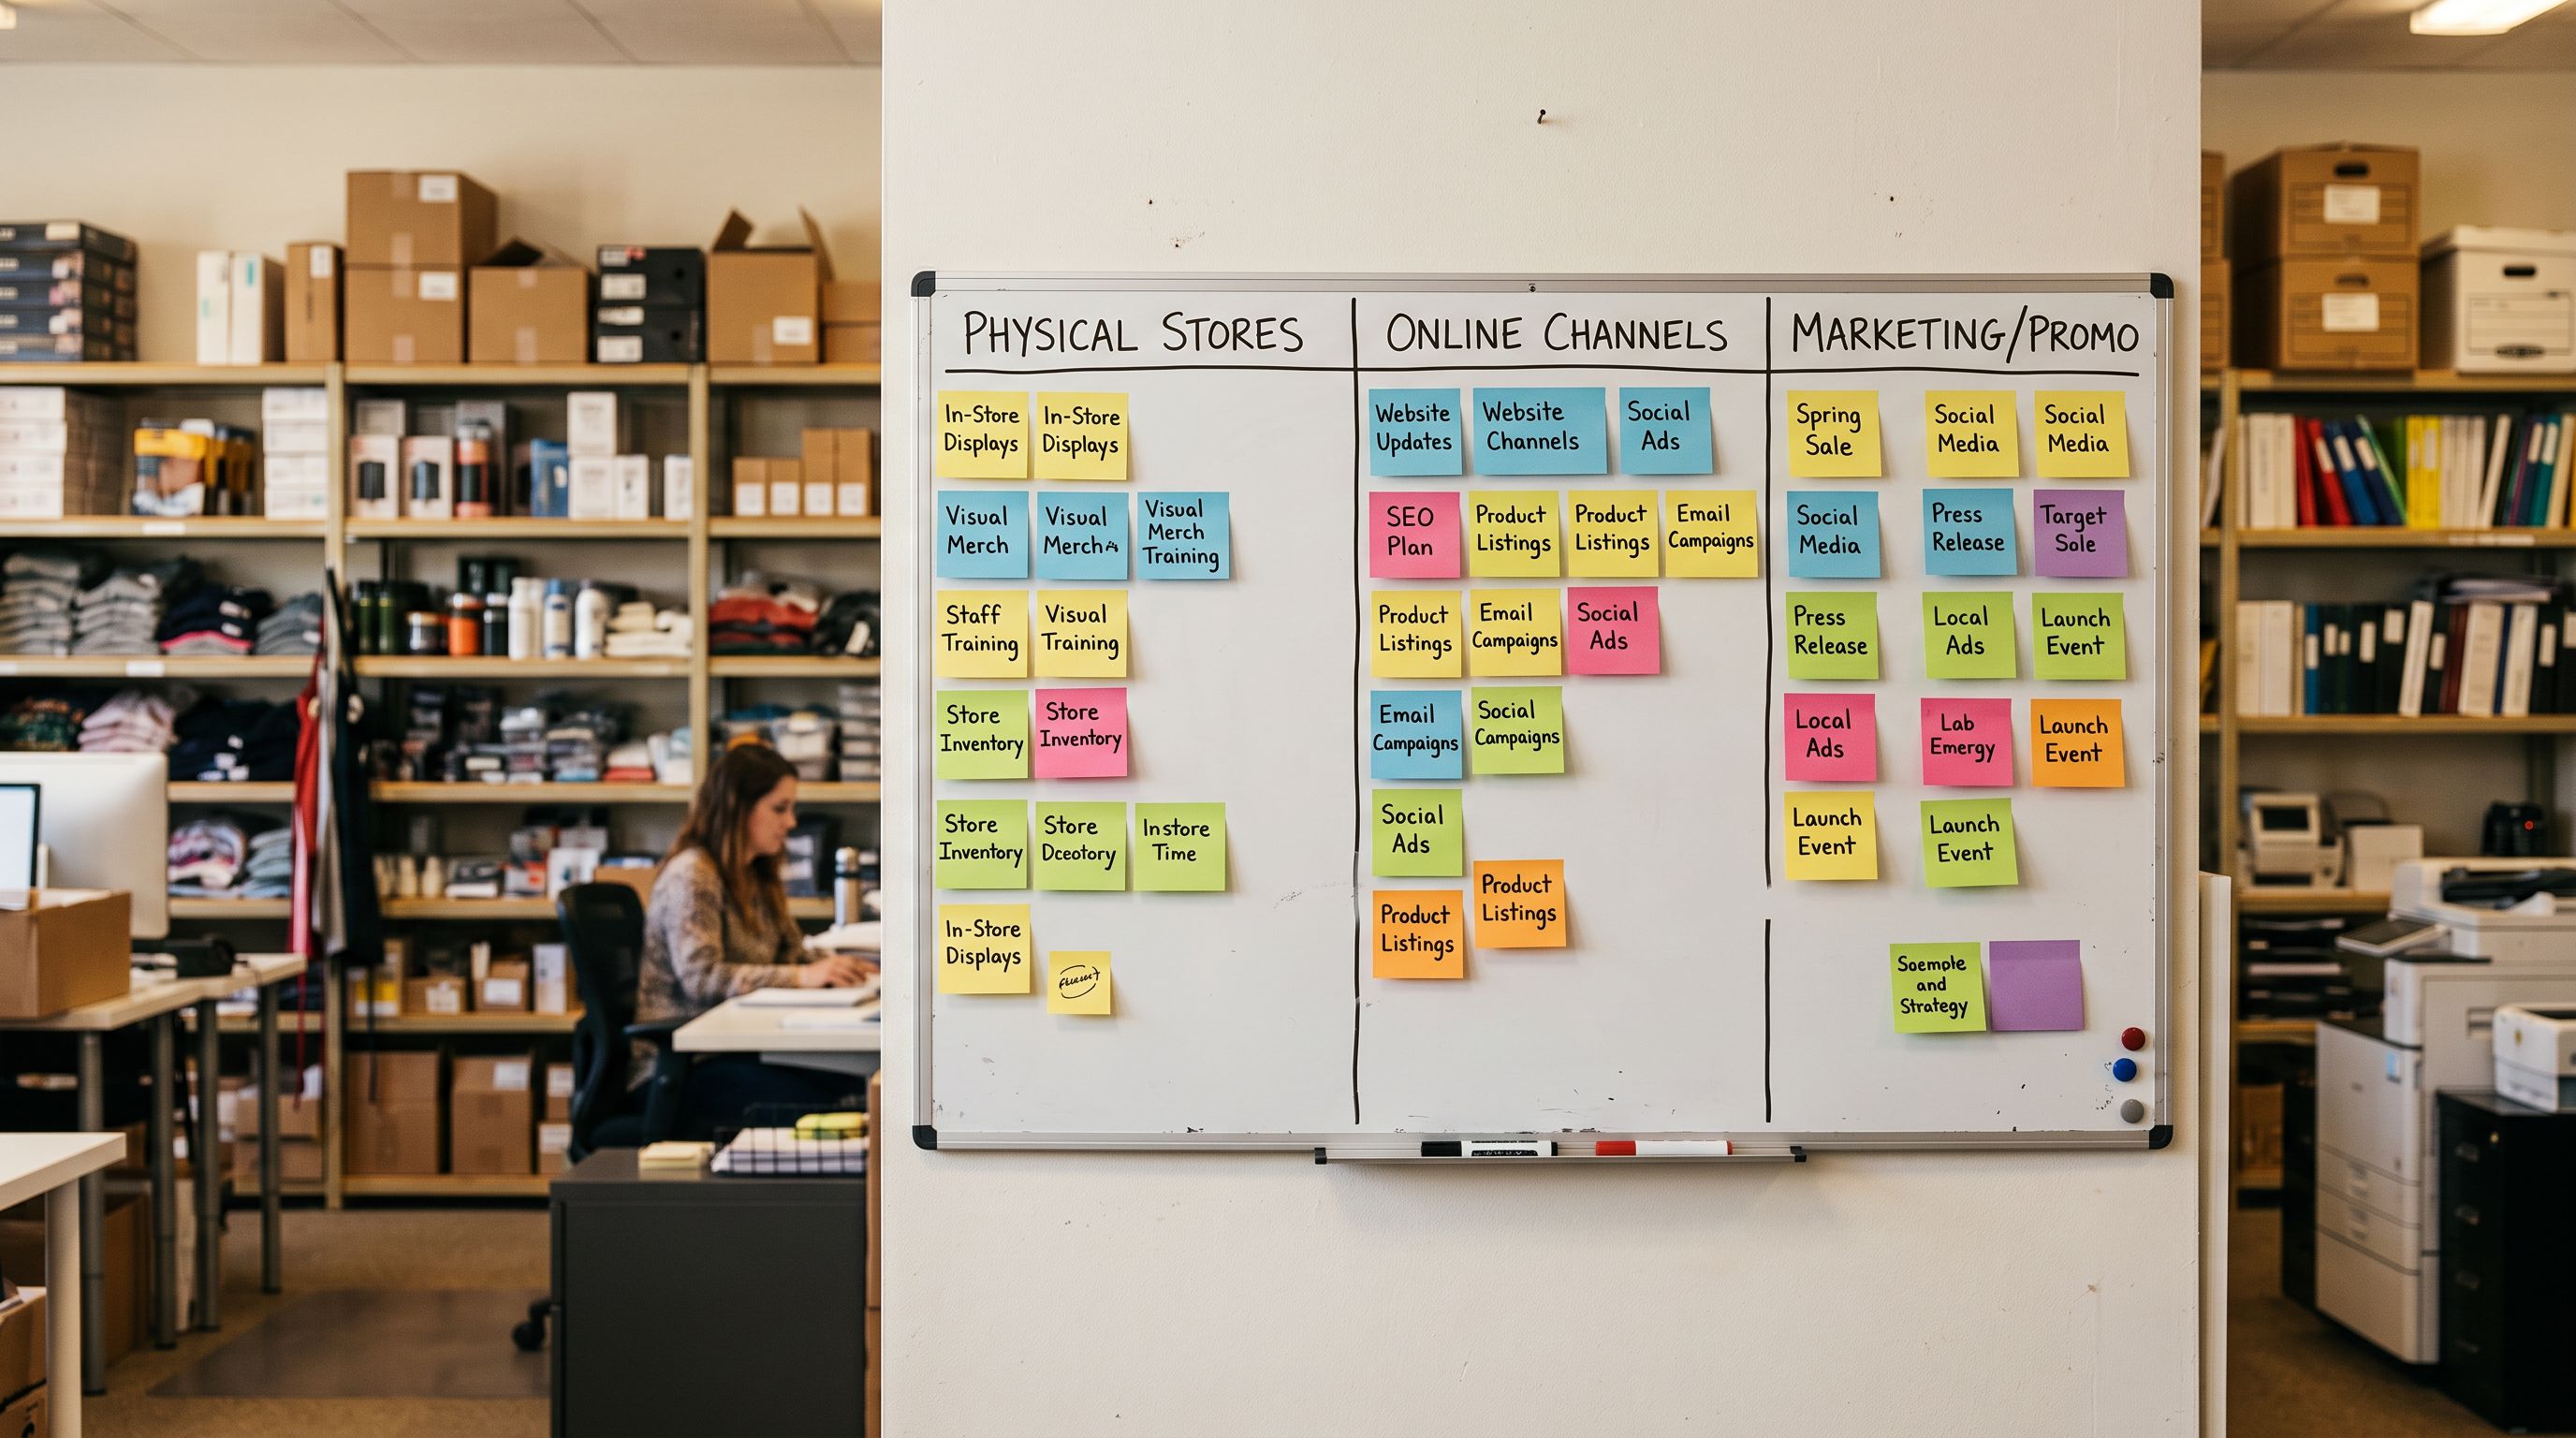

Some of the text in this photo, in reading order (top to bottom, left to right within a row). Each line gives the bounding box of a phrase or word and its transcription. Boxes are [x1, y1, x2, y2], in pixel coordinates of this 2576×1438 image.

[964, 310, 1304, 358] PHYSICAL STORES
[1386, 312, 1728, 352] ONLINE CHANNELS
[1793, 304, 2139, 364] MARKETING/PROMO
[945, 404, 1020, 424] In-Store
[1045, 405, 1120, 426] In-Store
[1375, 403, 1451, 423] Website
[1482, 401, 1565, 422] Website
[1628, 400, 1690, 422] Social
[1796, 403, 1861, 433] Spring
[1935, 404, 1995, 424] Social
[2044, 403, 2105, 425] Social
[944, 432, 1018, 460] Displays
[1043, 433, 1119, 462] Displays
[1376, 432, 1453, 458] Updates
[1486, 430, 1579, 451] Channels
[1641, 429, 1680, 451] Ads
[1806, 433, 1853, 457] Sale
[1939, 433, 2000, 453] Media
[2048, 433, 2110, 453] Media
[945, 505, 1007, 526] Visual
[1045, 506, 1107, 527] Visual
[1145, 498, 1203, 518] Visual
[1386, 506, 1434, 527] SEO
[1476, 504, 1547, 524] Product
[1575, 504, 1647, 523] Product
[1677, 503, 1730, 522] Email
[1796, 504, 1858, 526] Social
[1932, 501, 1983, 523] Press
[2039, 504, 2108, 534] Target
[1148, 522, 1205, 541] Merch
[1932, 531, 2005, 551] Release
[947, 535, 1009, 555] Merch
[1387, 536, 1433, 556] Plan
[1477, 533, 1551, 560] Listings
[1575, 533, 1650, 559] Listings
[1668, 530, 1754, 555] Campaigns
[1799, 534, 1862, 555] Media
[2055, 533, 2097, 553] Sole
[1142, 546, 1220, 573] Training
[946, 603, 1002, 624] Staff
[1045, 603, 1106, 624] Visual
[1379, 604, 1449, 624] Product
[1480, 602, 1532, 622] Email
[1577, 600, 1638, 623] Social
[1793, 604, 1846, 626] Press
[1934, 605, 1988, 626] Local
[2042, 607, 2111, 627] Launch
[941, 632, 1018, 662] Training
[1041, 632, 1119, 661] Training
[1380, 633, 1453, 660] Listings
[1471, 630, 1559, 655] Campaigns
[1589, 629, 1628, 650] Ads
[1793, 634, 1868, 655] Release
[1946, 634, 1985, 655] Ads
[2046, 635, 2105, 656] Event
[946, 704, 1001, 725] Store
[1046, 701, 1099, 721] Store
[1380, 703, 1435, 724] Email
[1478, 698, 1535, 720] Social
[1796, 708, 1852, 729] Local
[1941, 713, 1975, 731] Lab
[2040, 714, 2109, 735] Launch
[940, 733, 1024, 759] Inventory
[1040, 728, 1122, 754] Inventory
[1372, 733, 1459, 759] Campaigns
[1474, 727, 1560, 752] Campaigns
[1806, 737, 1844, 758] Ads
[1930, 737, 1996, 763] Emergy
[2046, 741, 2103, 763] Event
[944, 813, 998, 833] Store
[1382, 802, 1443, 825] Social
[1793, 807, 1862, 828] Launch
[1930, 814, 2000, 834] Launch
[1044, 814, 1098, 835] Store
[1151, 843, 1197, 862] Time
[1392, 832, 1430, 854] Ads
[1798, 835, 1857, 856] Event
[1938, 841, 1994, 863] Event
[939, 841, 1024, 869] Inventory
[1482, 873, 1552, 894] Product
[1382, 903, 1451, 924] Product
[1483, 902, 1557, 931] Listings
[946, 918, 1021, 938] In-Store
[1382, 932, 1455, 961] Listings
[946, 946, 1021, 973] Displays
[1916, 976, 1947, 991] and
[1900, 996, 1969, 1020] Strategy
